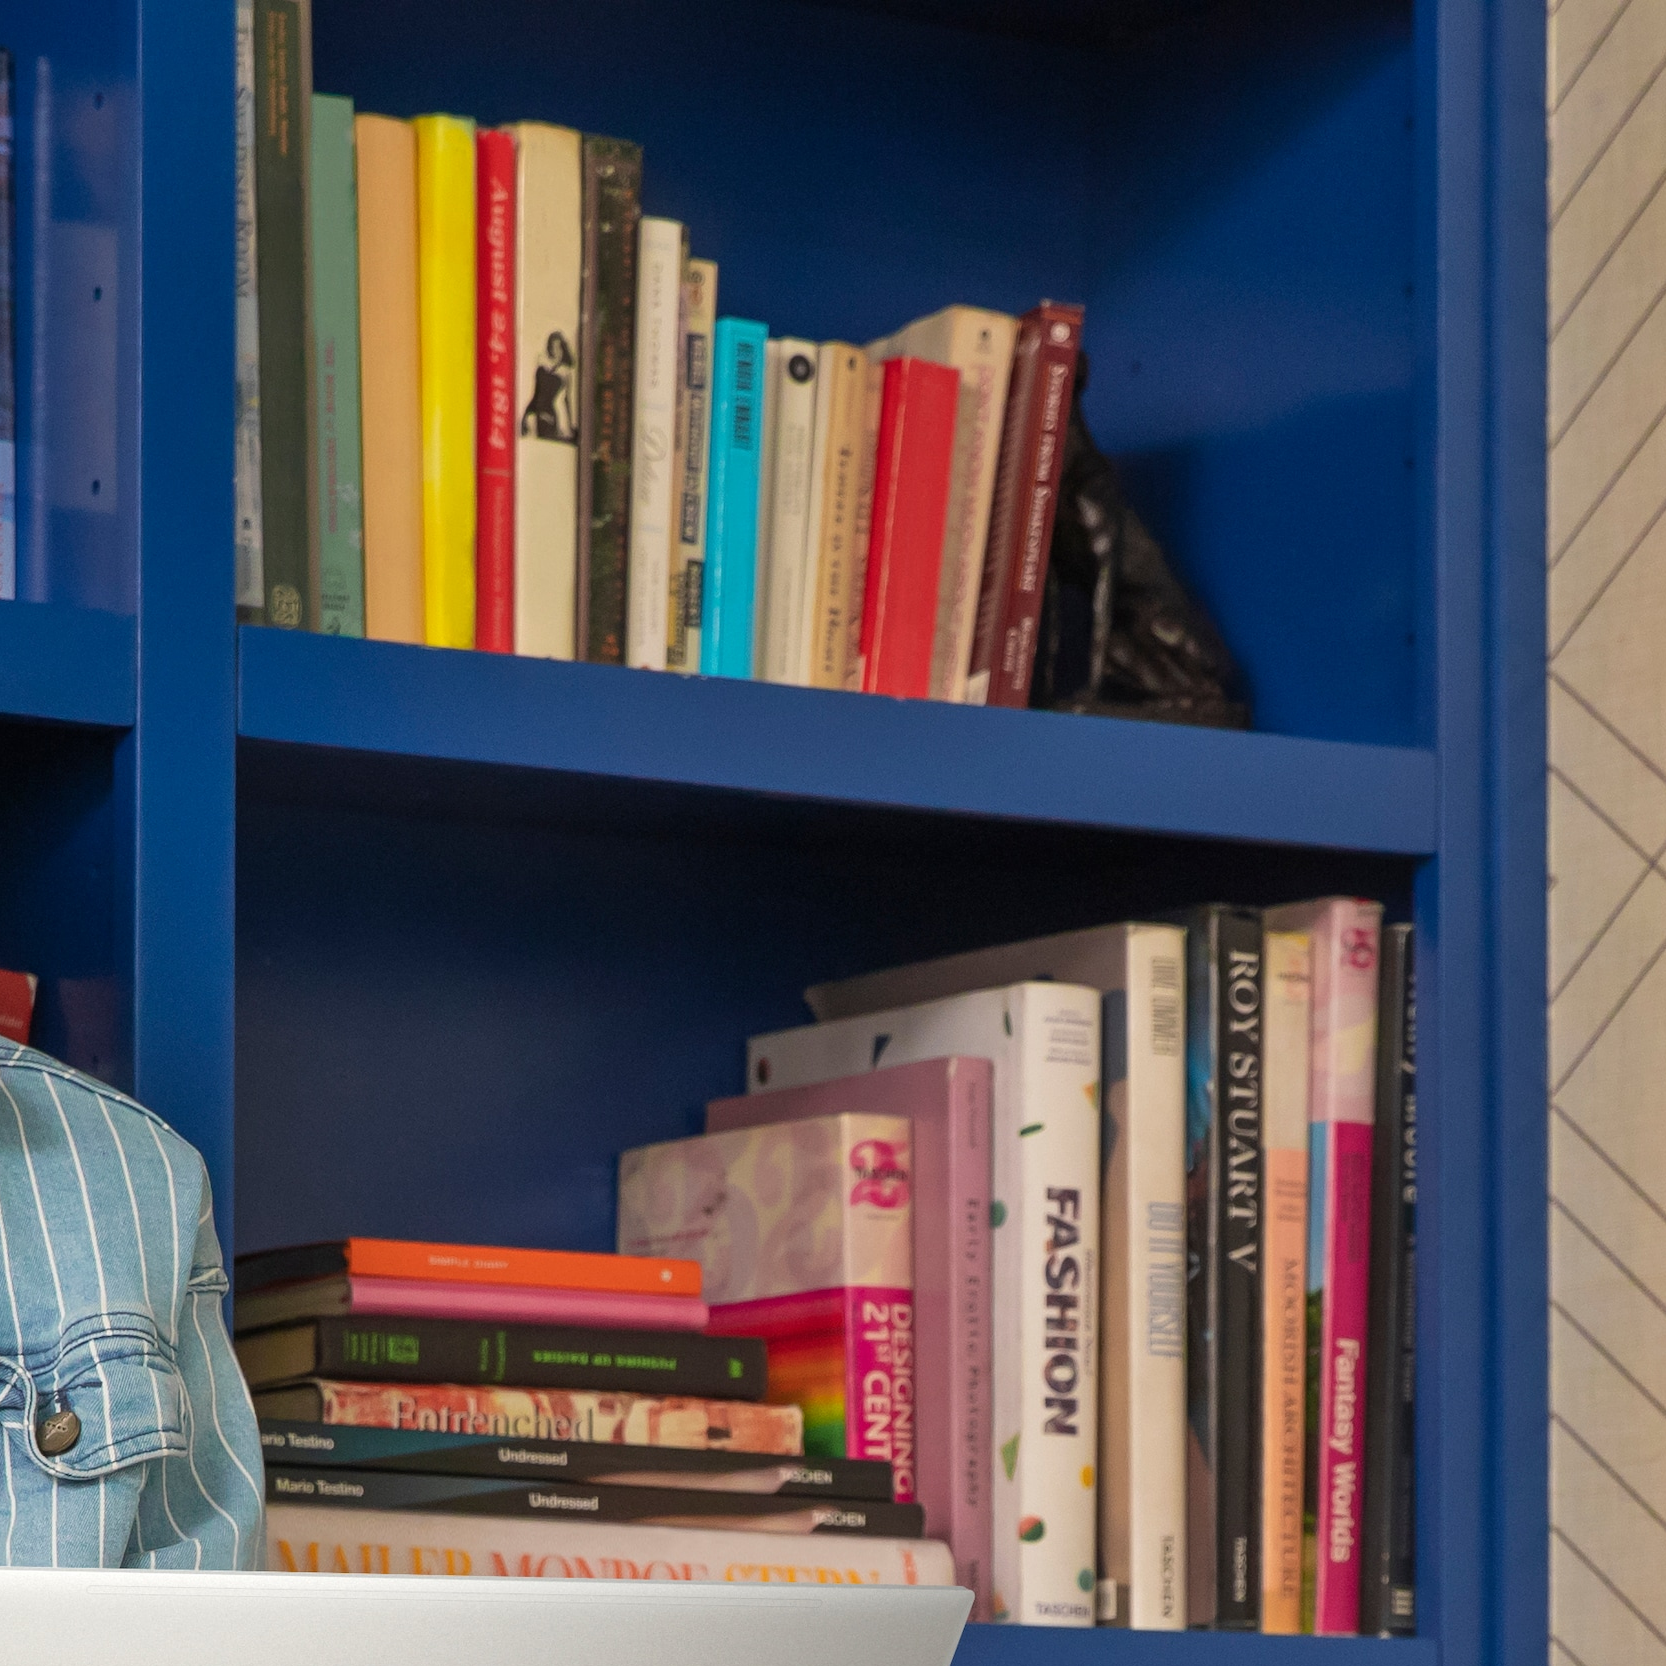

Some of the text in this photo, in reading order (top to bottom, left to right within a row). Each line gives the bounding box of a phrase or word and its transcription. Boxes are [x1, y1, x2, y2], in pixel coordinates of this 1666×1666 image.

[486, 175, 508, 450] August 24, 1814
[1226, 949, 1260, 1278] ROY STUART V
[1042, 1187, 1081, 1436] FASHION
[393, 1397, 595, 1442] Entrenched
[862, 1370, 893, 1460] CENT
[891, 1303, 914, 1494] DESIGNING
[261, 1433, 334, 1450] ario Testino
[498, 1447, 568, 1467] Undressed
[1327, 1338, 1359, 1566] Fantasy Worlds
[275, 1477, 364, 1498] Mario Testino
[780, 1469, 833, 1485] TASCHEN
[528, 1492, 599, 1511] Undressed
[812, 1511, 866, 1528] TASCHEN
